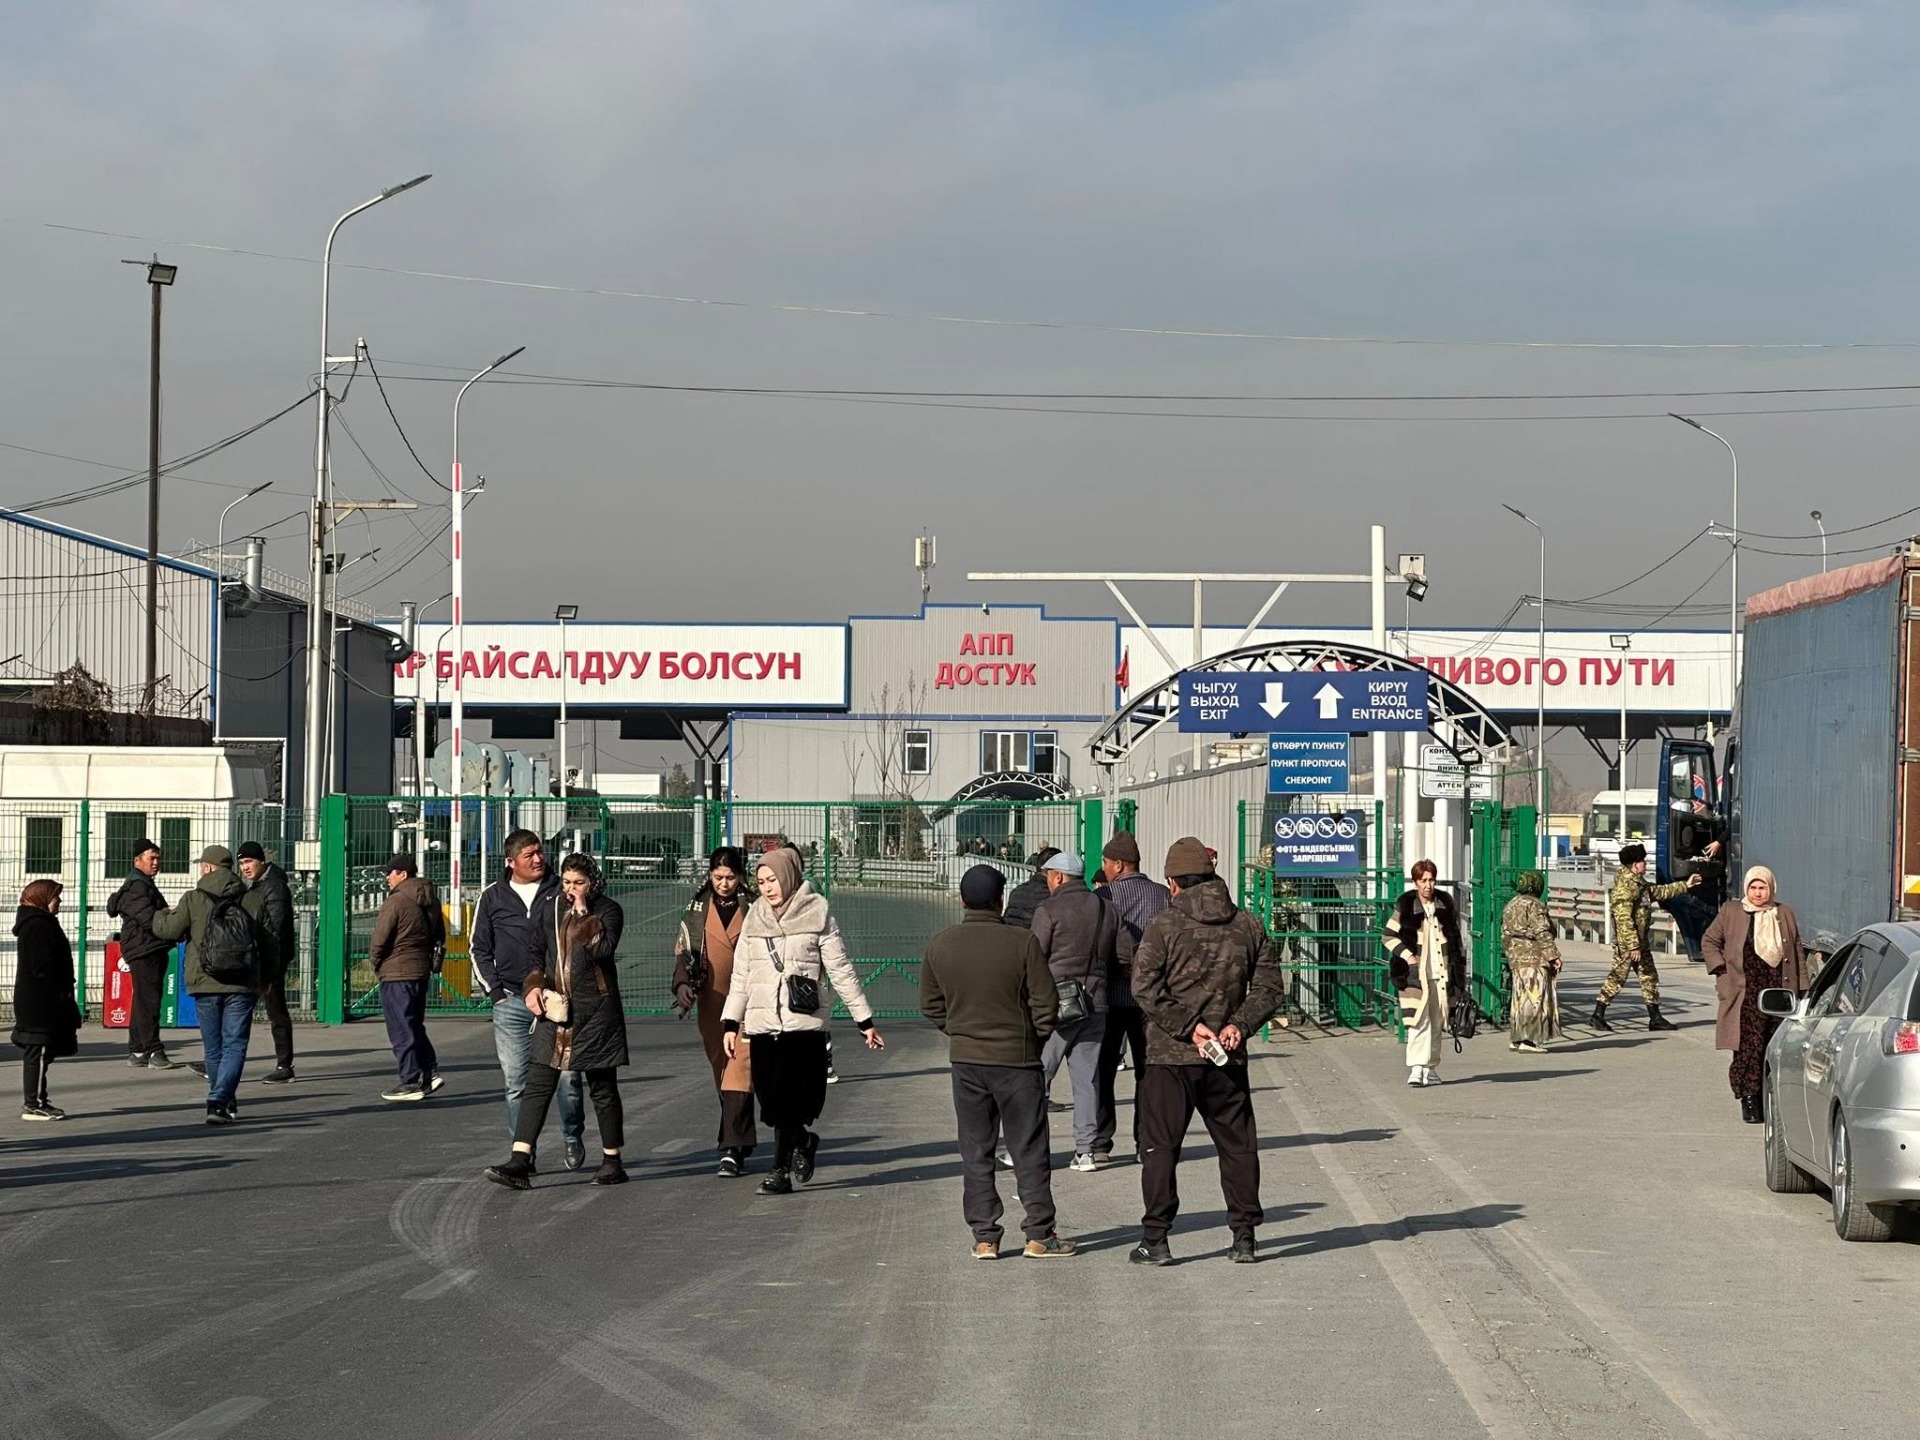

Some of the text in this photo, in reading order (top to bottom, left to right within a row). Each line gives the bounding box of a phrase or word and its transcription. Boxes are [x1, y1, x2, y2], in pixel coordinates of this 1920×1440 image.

[959, 632, 1014, 656] АПП
[436, 645, 651, 685] БАЙСАЛДУУ
[659, 651, 802, 681] БОЛСУН
[934, 662, 1036, 689] ДОСТУК
[1579, 657, 1676, 687] ПУТИ
[1192, 682, 1238, 693] ЧЫГУУ
[1190, 695, 1240, 709] ВЫХОД
[1370, 695, 1408, 708] ВХОД
[1199, 709, 1229, 720] EXIT
[1352, 708, 1424, 720] ENTRANCE
[1312, 741, 1346, 750] ПУНКТУ
[1270, 759, 1347, 768] ПУНКТ ПРОПУСКА
[1284, 776, 1333, 785] CHEKPOINT
